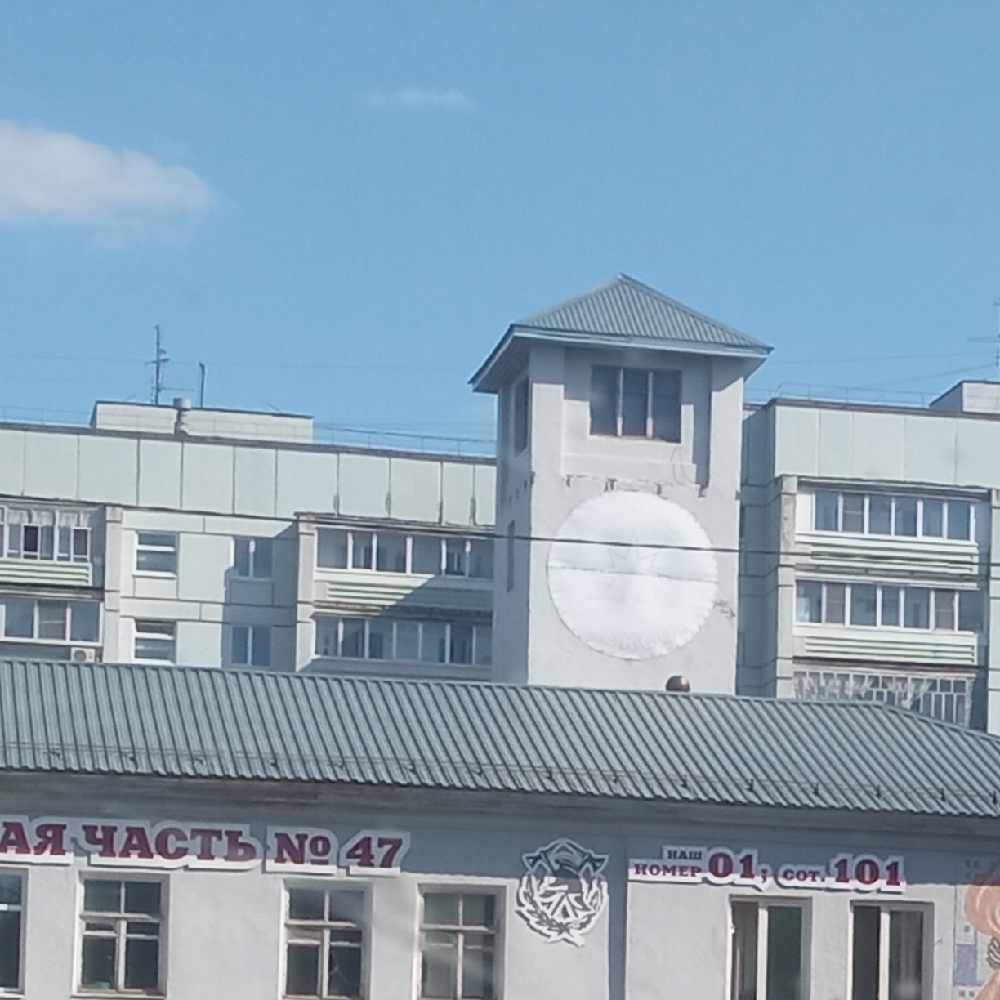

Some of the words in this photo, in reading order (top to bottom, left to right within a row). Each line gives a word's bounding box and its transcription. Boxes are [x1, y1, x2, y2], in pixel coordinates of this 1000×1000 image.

[81, 824, 257, 862] ЧАСТЬ
[345, 837, 404, 868] 47
[667, 849, 702, 860] НАШ
[634, 863, 702, 877] НОМЕР
[834, 858, 901, 886] 101
